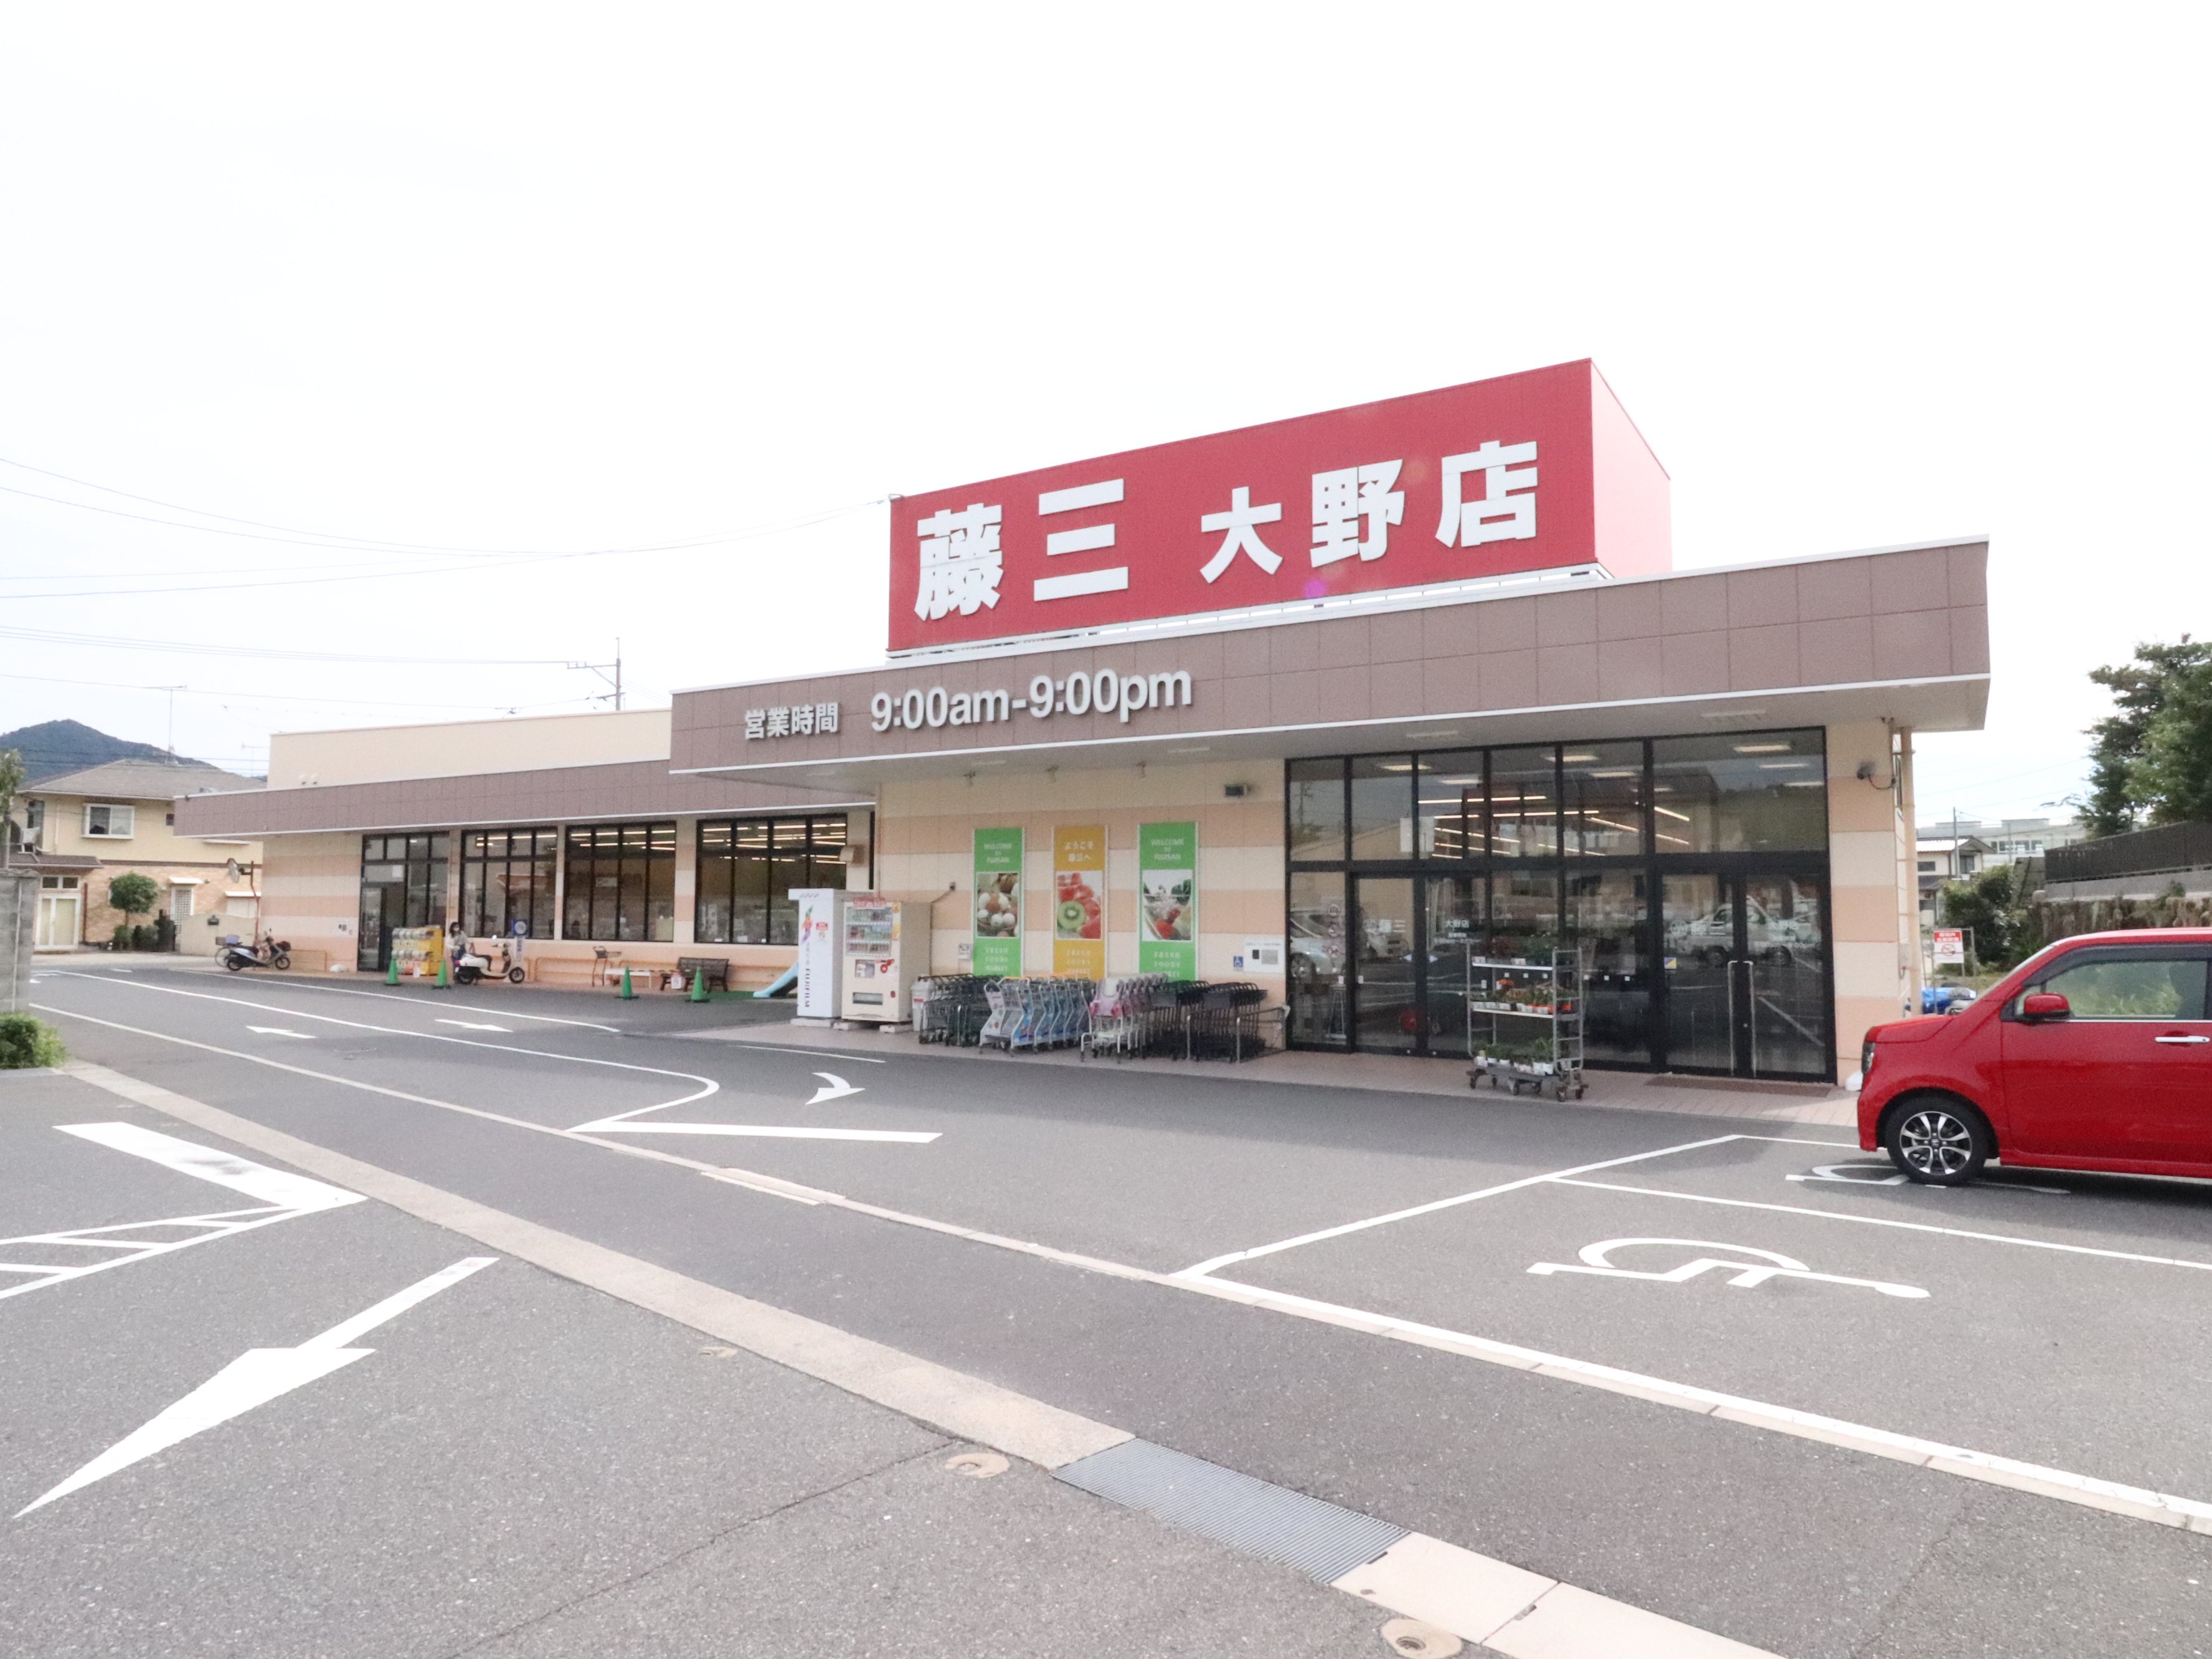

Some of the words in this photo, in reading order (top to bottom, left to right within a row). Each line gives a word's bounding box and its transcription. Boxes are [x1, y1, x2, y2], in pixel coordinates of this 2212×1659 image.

[914, 478, 1129, 622] 藤三
[1199, 440, 1538, 584] 大野店
[744, 702, 839, 740] 営業時間
[871, 668, 1192, 732] 9:00am-9:00pm
